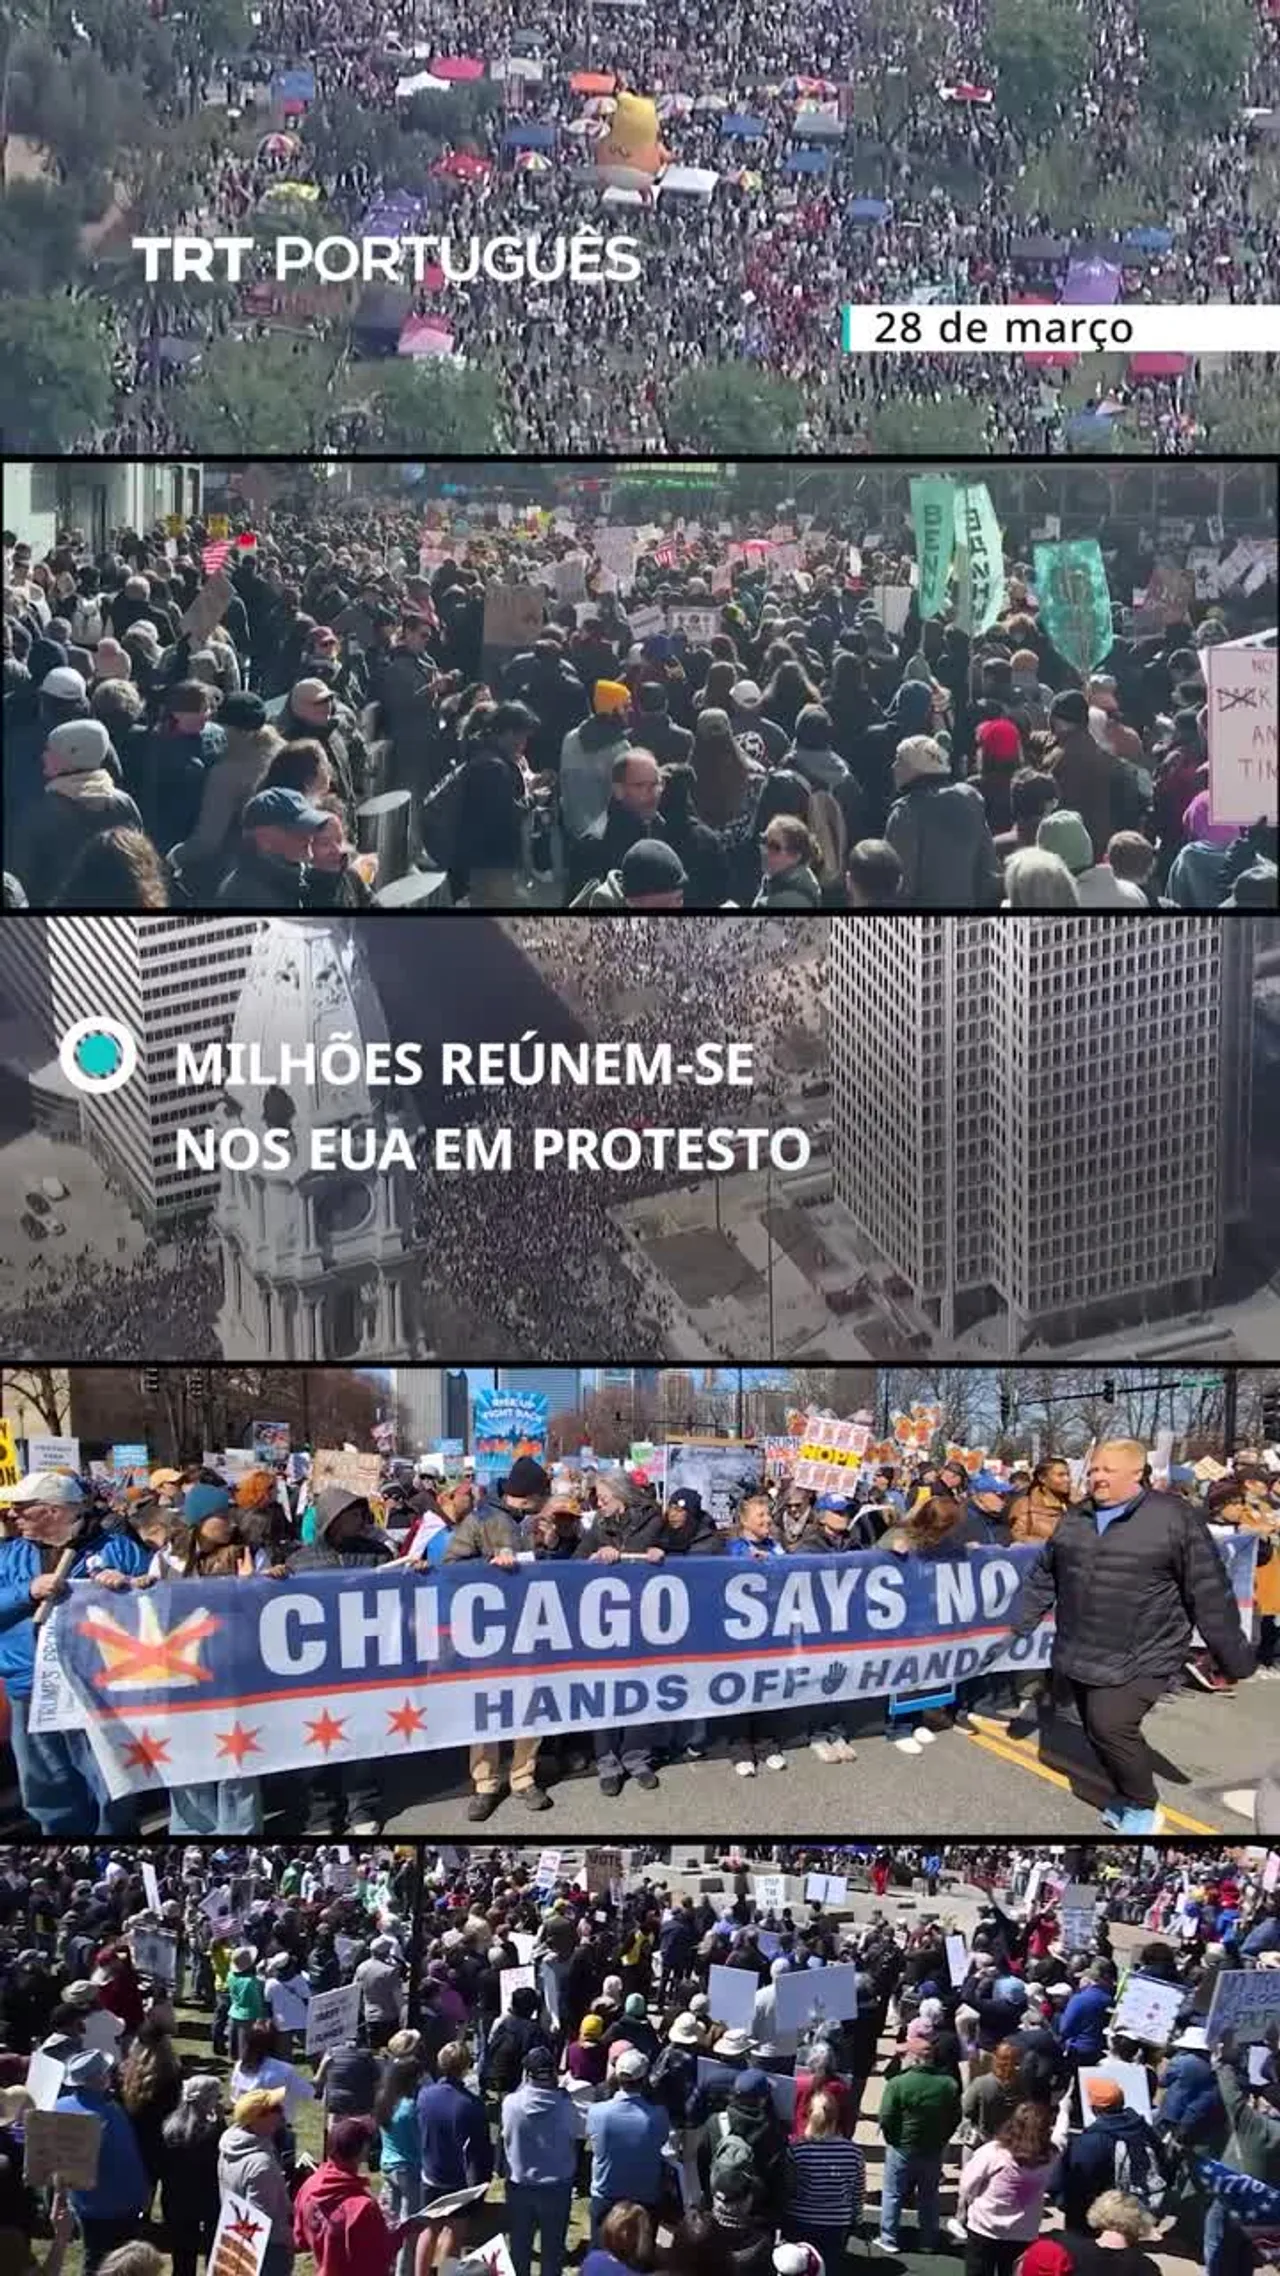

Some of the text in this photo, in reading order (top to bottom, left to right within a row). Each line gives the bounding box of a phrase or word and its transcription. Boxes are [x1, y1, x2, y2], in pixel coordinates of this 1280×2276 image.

[258, 1559, 1019, 1677] CHICAGO SAYS NO
[473, 1668, 688, 1732] HANDS
[708, 1665, 811, 1706] OFF
